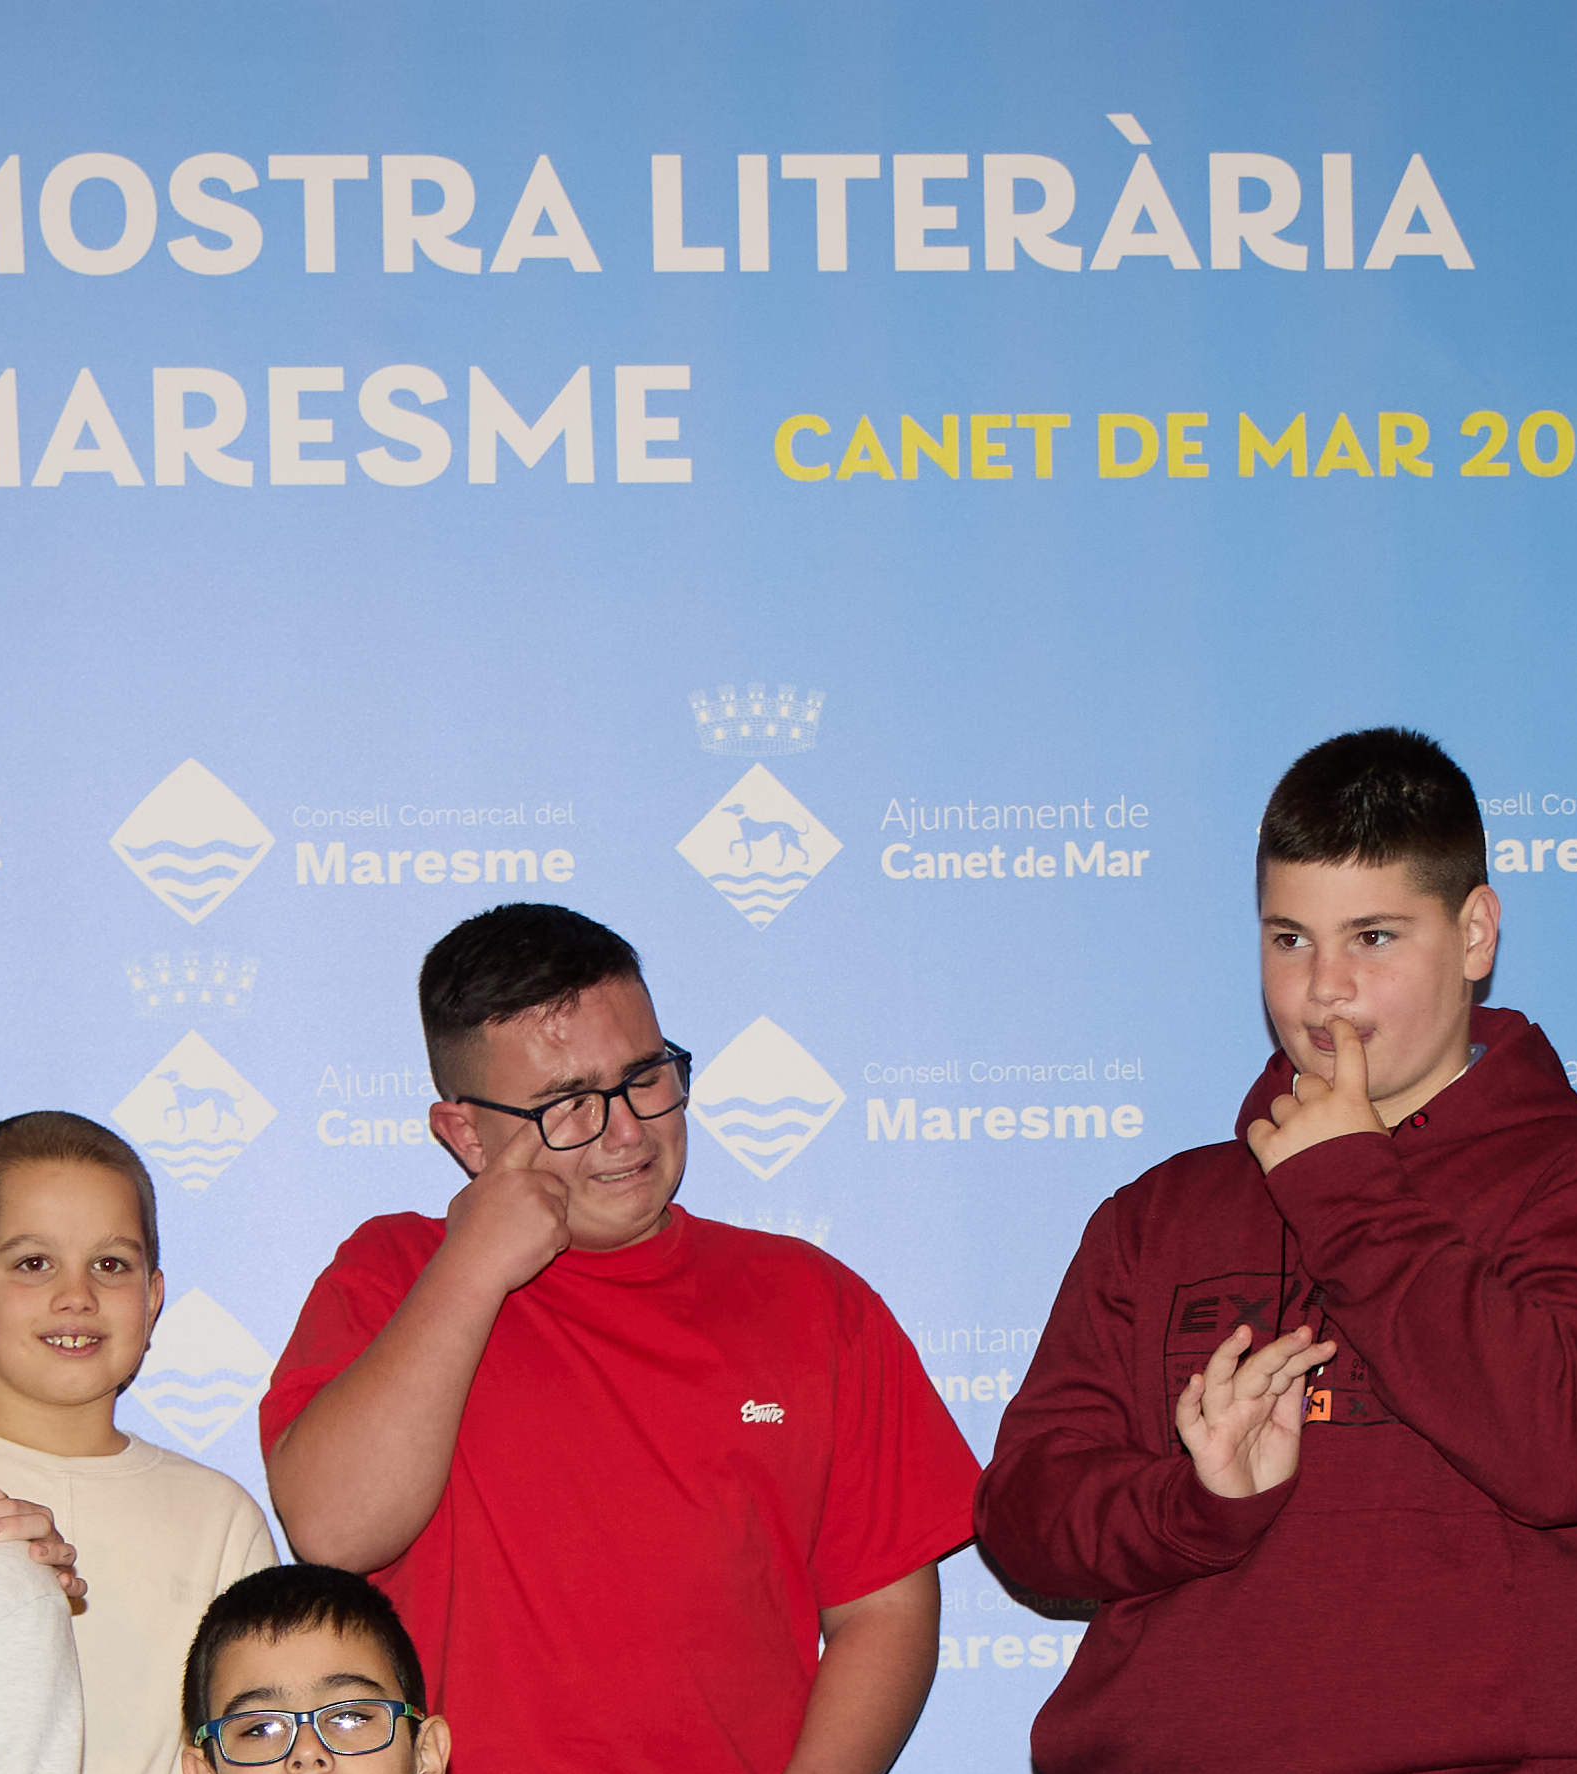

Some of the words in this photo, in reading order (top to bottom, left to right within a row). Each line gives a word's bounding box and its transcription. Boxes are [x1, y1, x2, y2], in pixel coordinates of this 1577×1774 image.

[653, 114, 1476, 273] LITERÀRIA
[776, 415, 1071, 482] CANET
[1099, 414, 1209, 479] DE
[1240, 413, 1434, 478] MAR
[294, 805, 391, 828] Consell
[400, 804, 527, 827] Comarcal
[536, 803, 575, 825] del
[882, 799, 1096, 839] Ajuntament
[1106, 796, 1150, 829] de
[1477, 792, 1533, 816] nsell
[297, 842, 575, 885] Maresme
[883, 844, 1006, 880] Canet
[1014, 847, 1057, 879] de
[1066, 842, 1150, 878] Mar
[317, 1064, 436, 1104] Ajunta
[865, 1062, 961, 1084] Consell
[970, 1060, 1096, 1083] Comarcal
[1105, 1059, 1145, 1081] del
[868, 1099, 1144, 1142] Maresme
[938, 1634, 1085, 1669] ares
